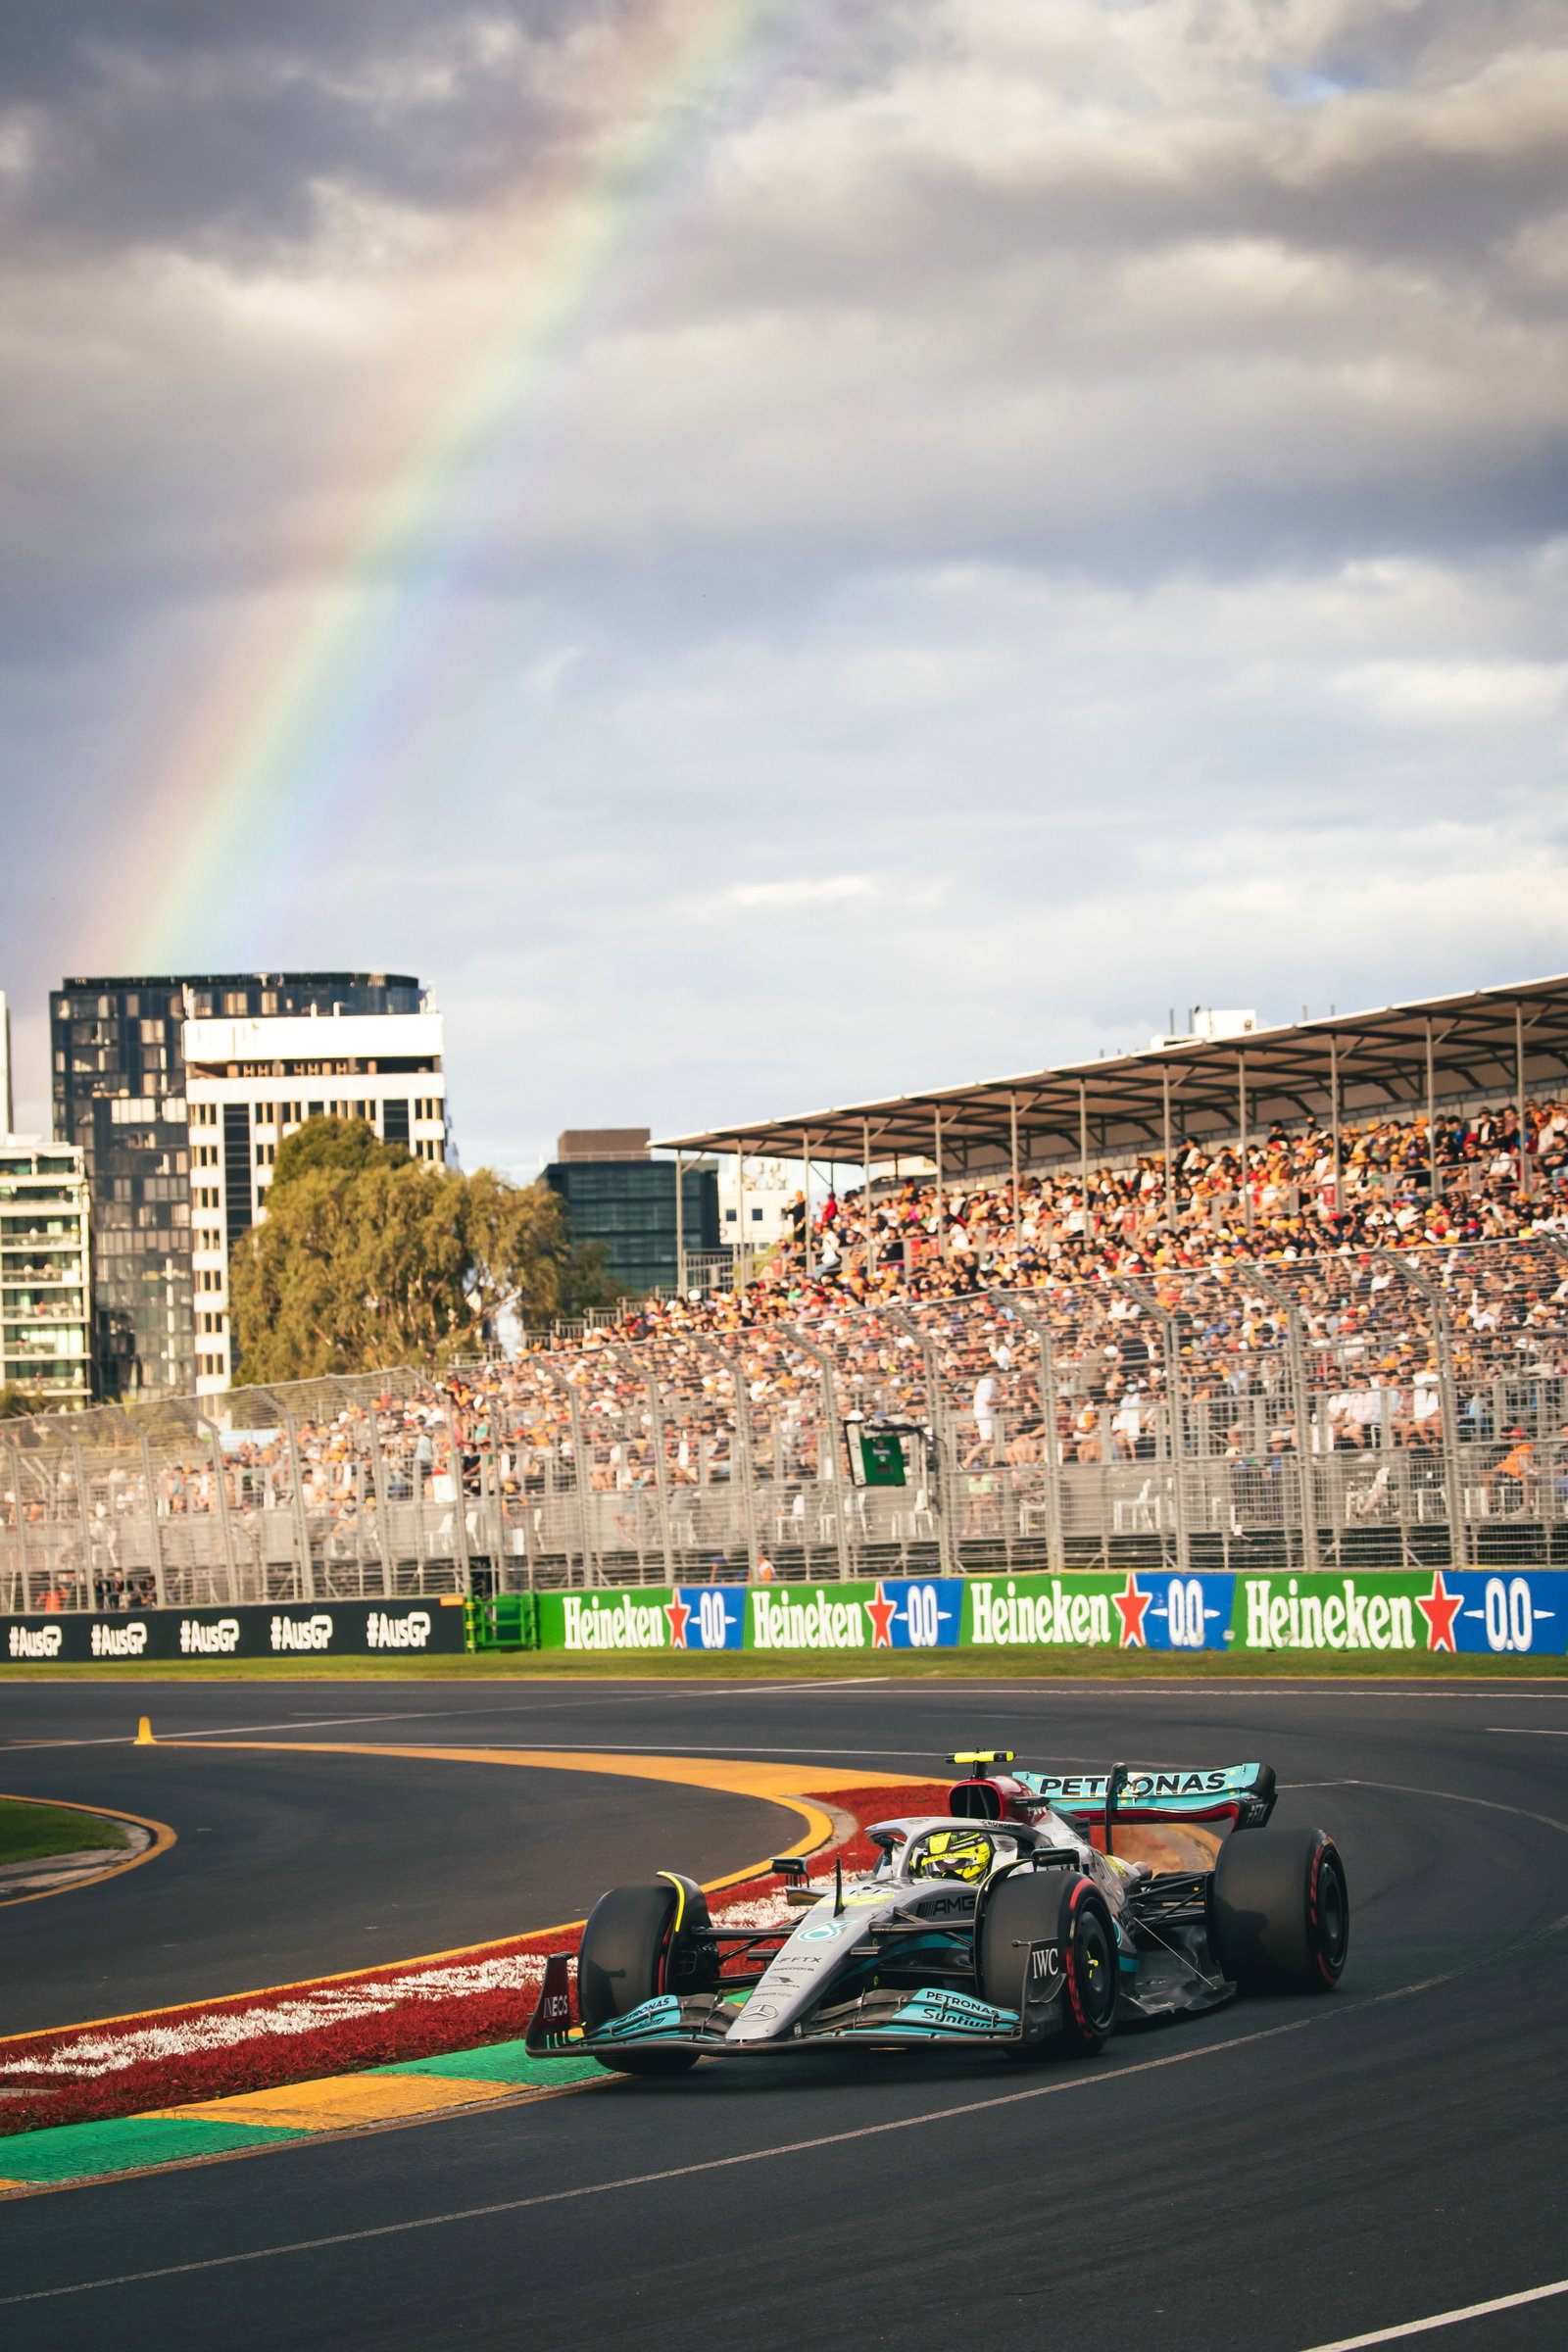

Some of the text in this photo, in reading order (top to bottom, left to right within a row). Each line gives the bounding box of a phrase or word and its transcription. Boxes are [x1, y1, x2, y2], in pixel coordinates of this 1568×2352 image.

[563, 1593, 664, 1649] Heineken
[752, 1590, 863, 1649] Heineken
[970, 1581, 1111, 1644] Heineken
[1245, 1577, 1533, 1652] Heineken 0.0
[933, 1895, 975, 1917] AMG
[1032, 1948, 1058, 1979] IWC
[543, 1995, 568, 2019] INEOS
[922, 2008, 998, 2029] Syntium
[926, 1991, 999, 2016] PETRONAS
